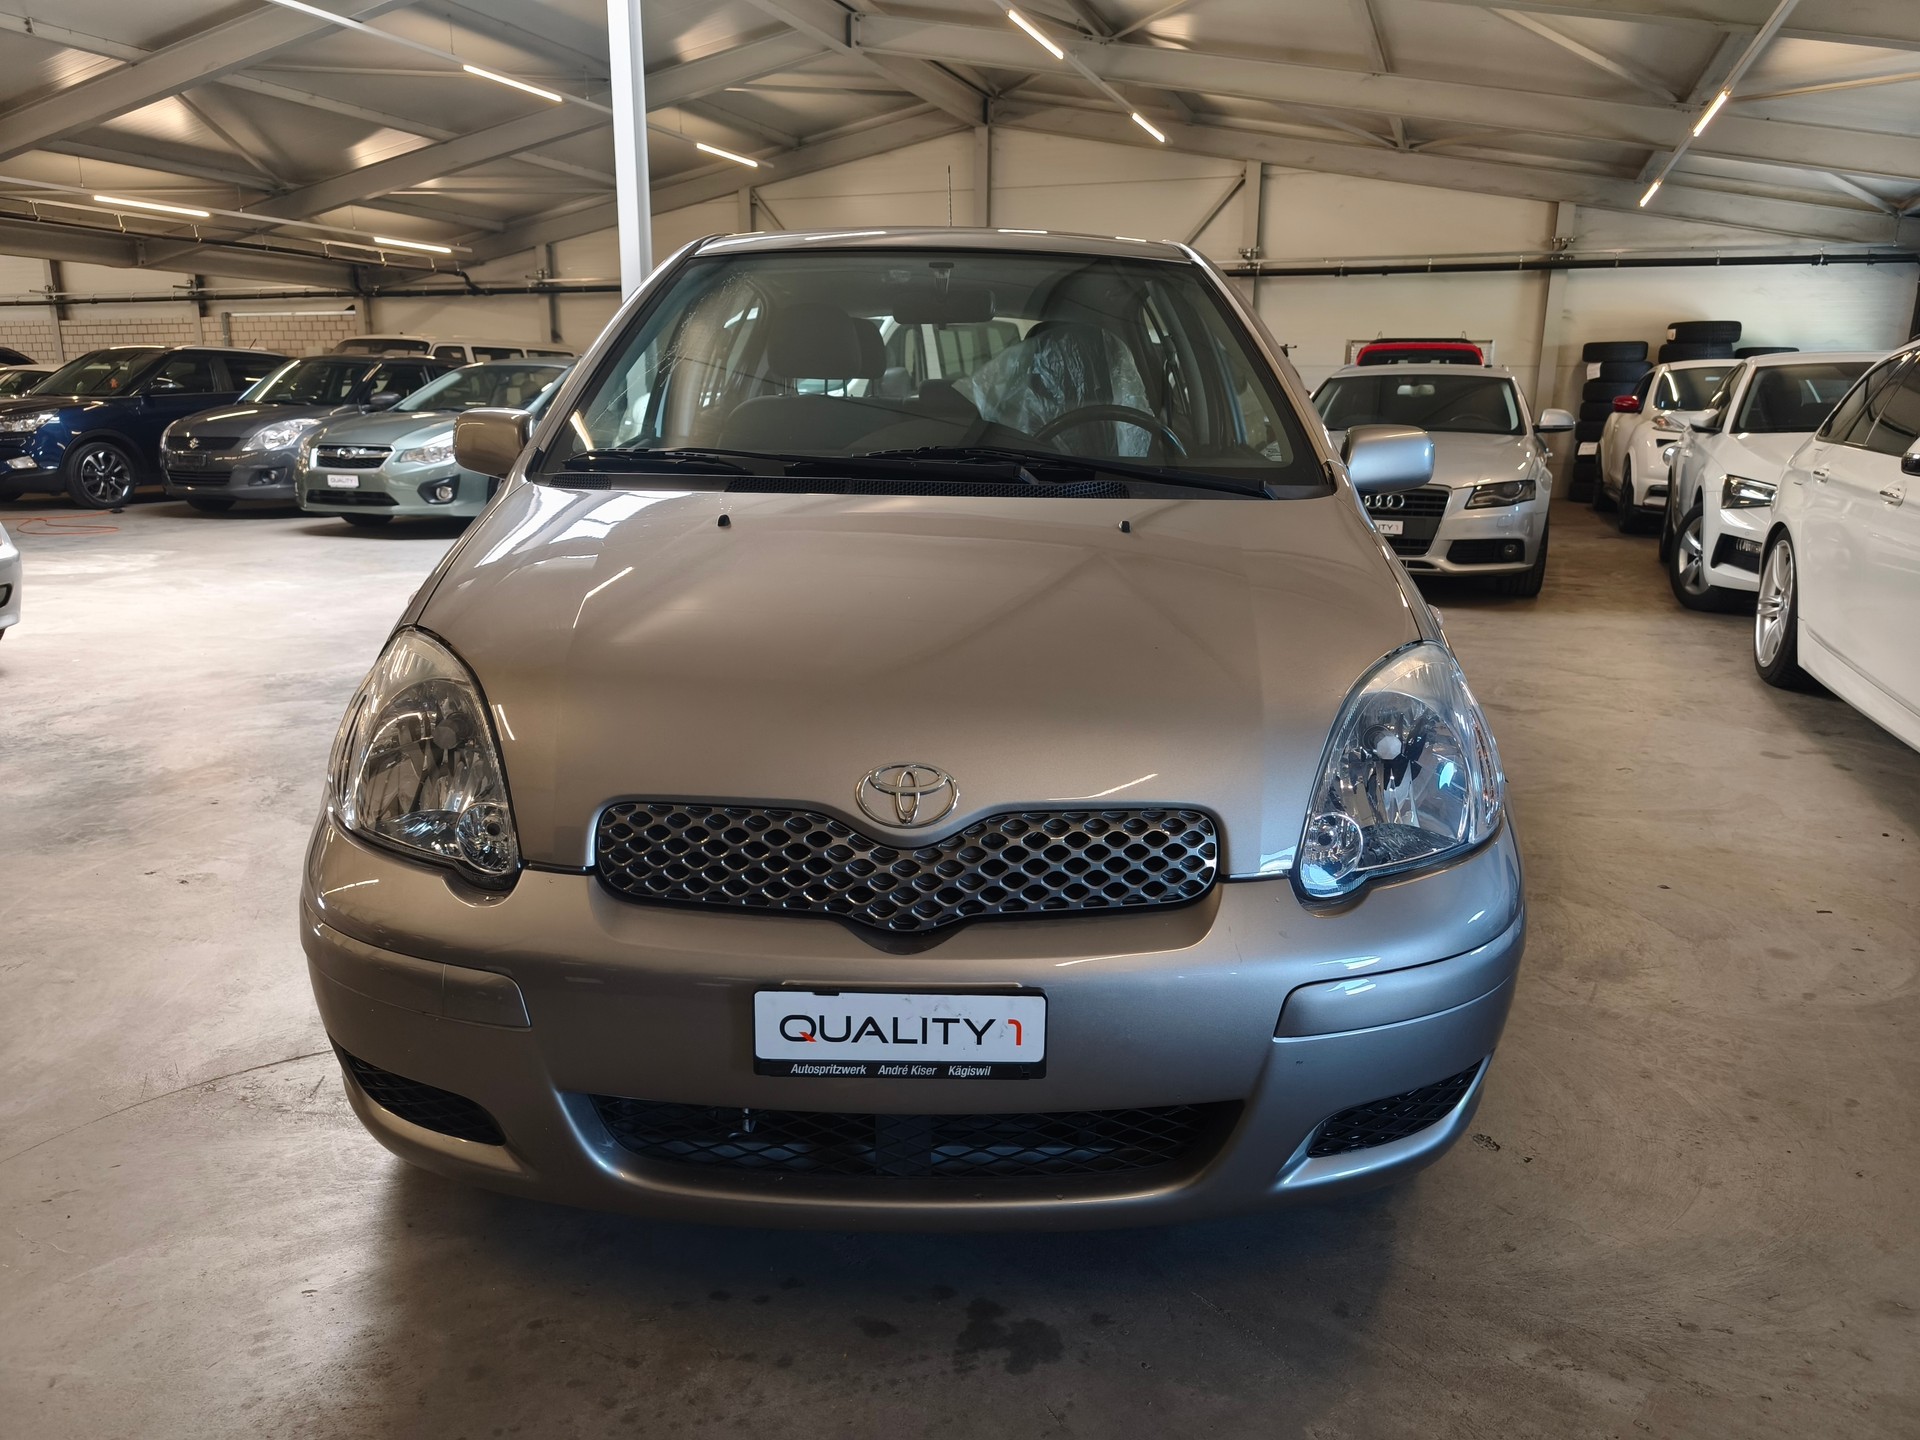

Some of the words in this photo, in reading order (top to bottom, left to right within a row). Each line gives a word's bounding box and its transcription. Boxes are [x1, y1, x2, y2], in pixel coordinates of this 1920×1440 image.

[779, 1014, 997, 1046] QUALITY
[1007, 1018, 1022, 1046] 1
[790, 1063, 867, 1076] Autospritzwerk
[878, 1064, 909, 1076] André
[910, 1065, 938, 1076] Kiser
[948, 1065, 992, 1078] Kägiswil
